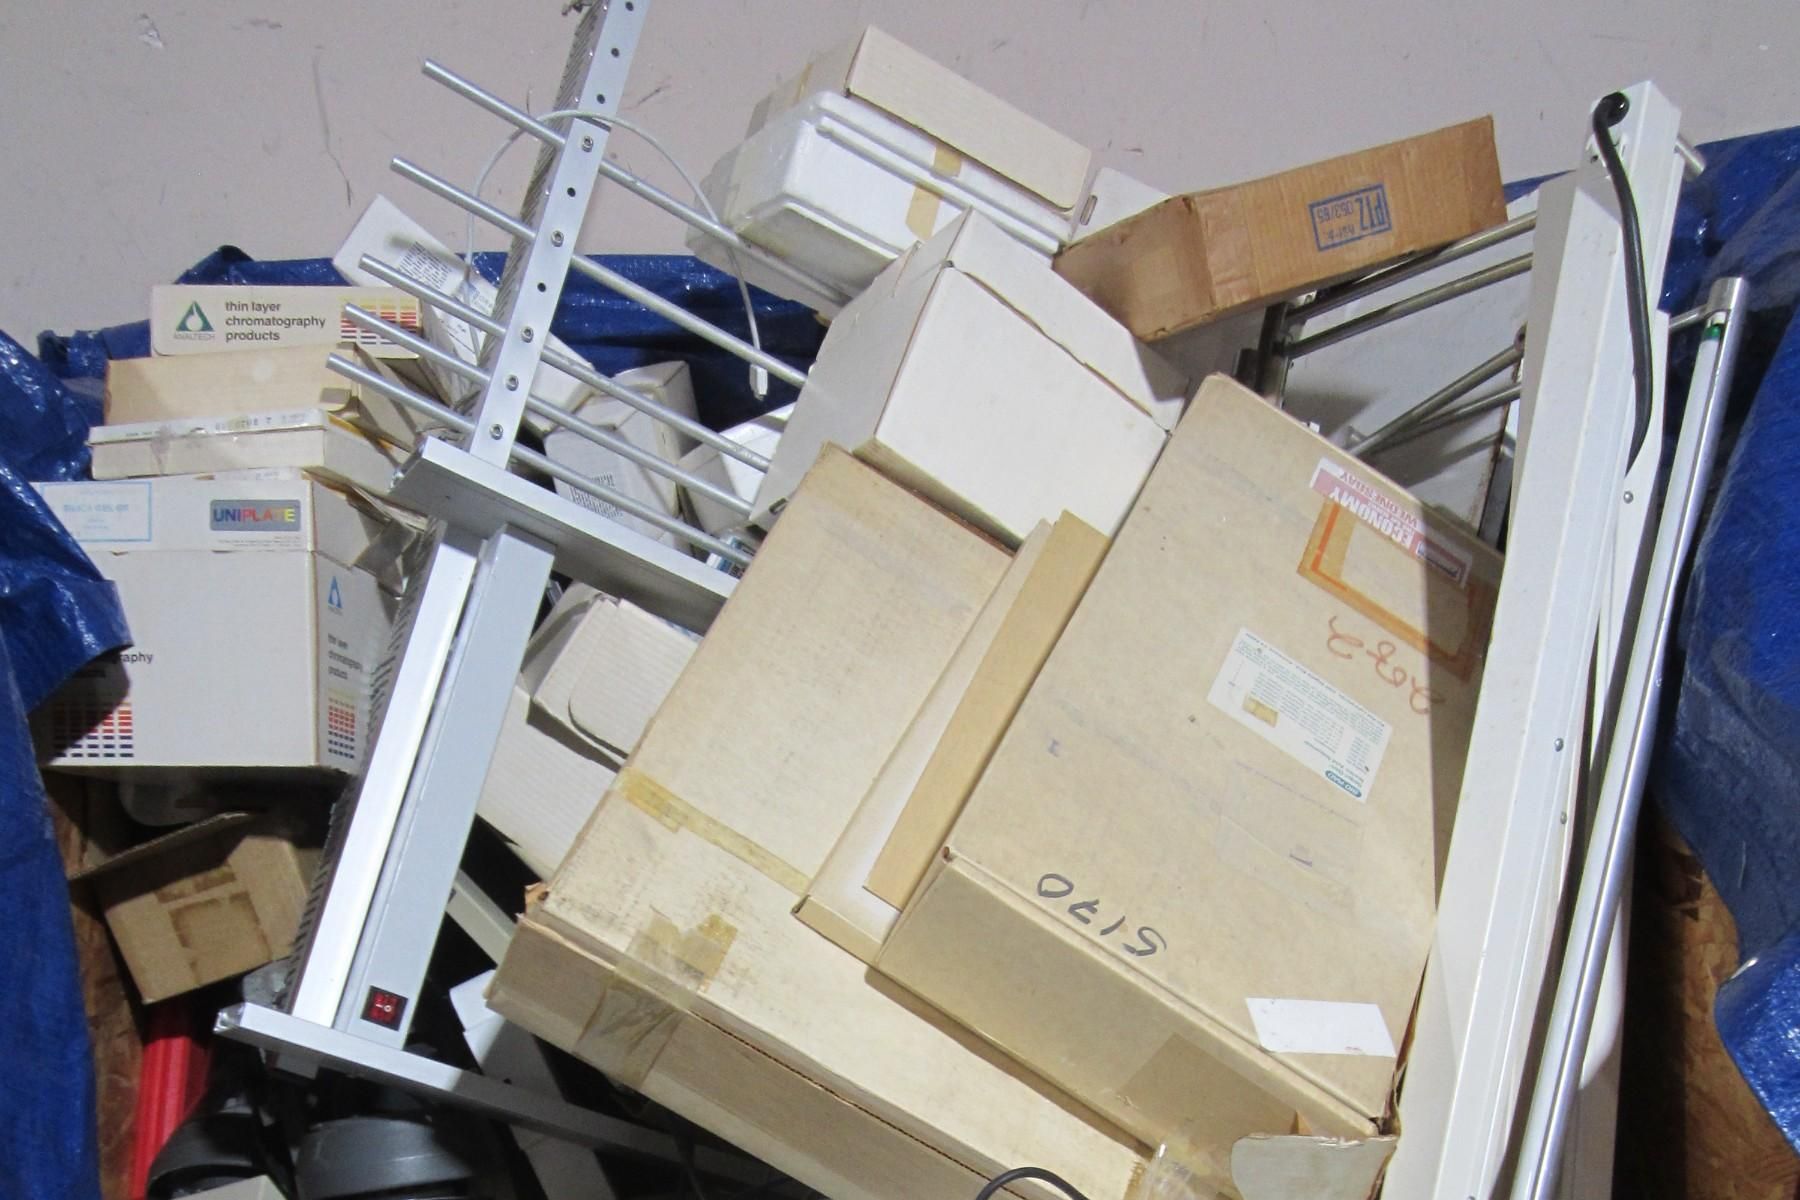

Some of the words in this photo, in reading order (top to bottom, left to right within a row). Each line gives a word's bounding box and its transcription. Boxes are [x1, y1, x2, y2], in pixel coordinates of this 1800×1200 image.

[225, 301, 249, 312] thin
[251, 301, 281, 315] layer
[225, 316, 326, 329] chromatography
[225, 331, 280, 343] products
[213, 507, 296, 523] UNIPLATE
[1329, 485, 1413, 546] ECONOMY
